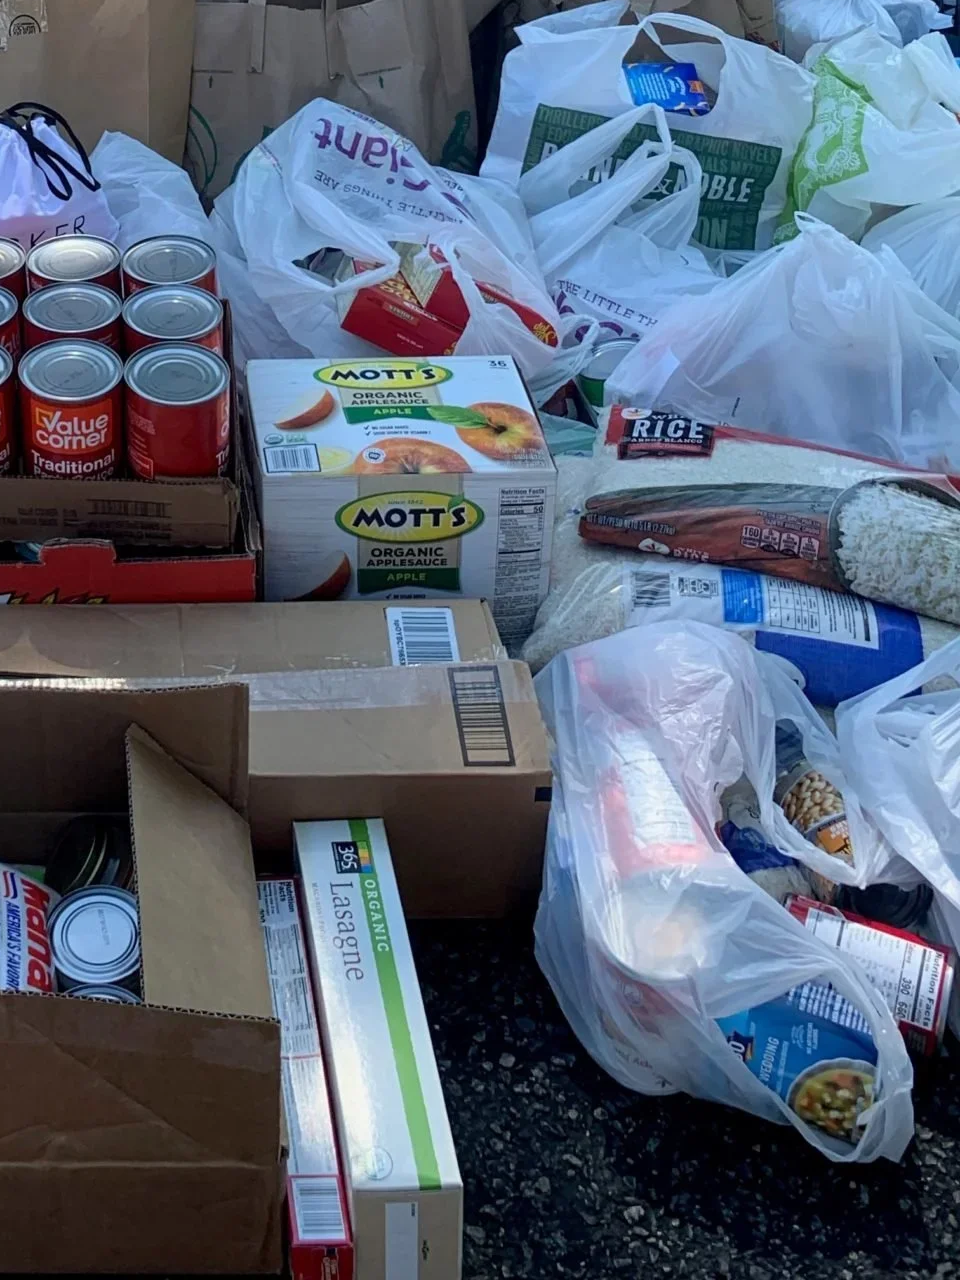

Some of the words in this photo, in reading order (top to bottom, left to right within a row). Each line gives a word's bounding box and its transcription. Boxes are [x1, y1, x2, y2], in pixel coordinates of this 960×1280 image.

[314, 169, 341, 190] ARE
[557, 279, 580, 295] THE
[584, 289, 636, 319] LITTLE
[330, 368, 436, 381] MOTT'S
[489, 360, 507, 368] 36
[350, 397, 430, 406] APPLESAUCE
[352, 391, 423, 399] ORGANIC
[372, 407, 413, 415] APPLE
[42, 410, 109, 435] Value
[631, 419, 704, 439] RICE
[35, 427, 108, 449] corner
[31, 448, 115, 475] Traditional
[352, 506, 466, 528] MOTT'S
[533, 505, 544, 514] 50
[742, 525, 759, 538] 160
[366, 558, 448, 567] APPLESAUCE
[371, 547, 444, 558] ORGANIC
[387, 572, 426, 581] APPLE
[337, 844, 358, 870] 365
[278, 881, 286, 902] Facts
[285, 881, 295, 913] Nutrition
[364, 879, 390, 952] ORGANIC
[5, 901, 21, 952] AMERICA'S
[329, 880, 364, 982] Lasagne
[924, 951, 943, 995] Nutrition
[900, 976, 913, 996] 390
[922, 994, 936, 1028] Facts
[760, 1035, 780, 1082] WEDDING
